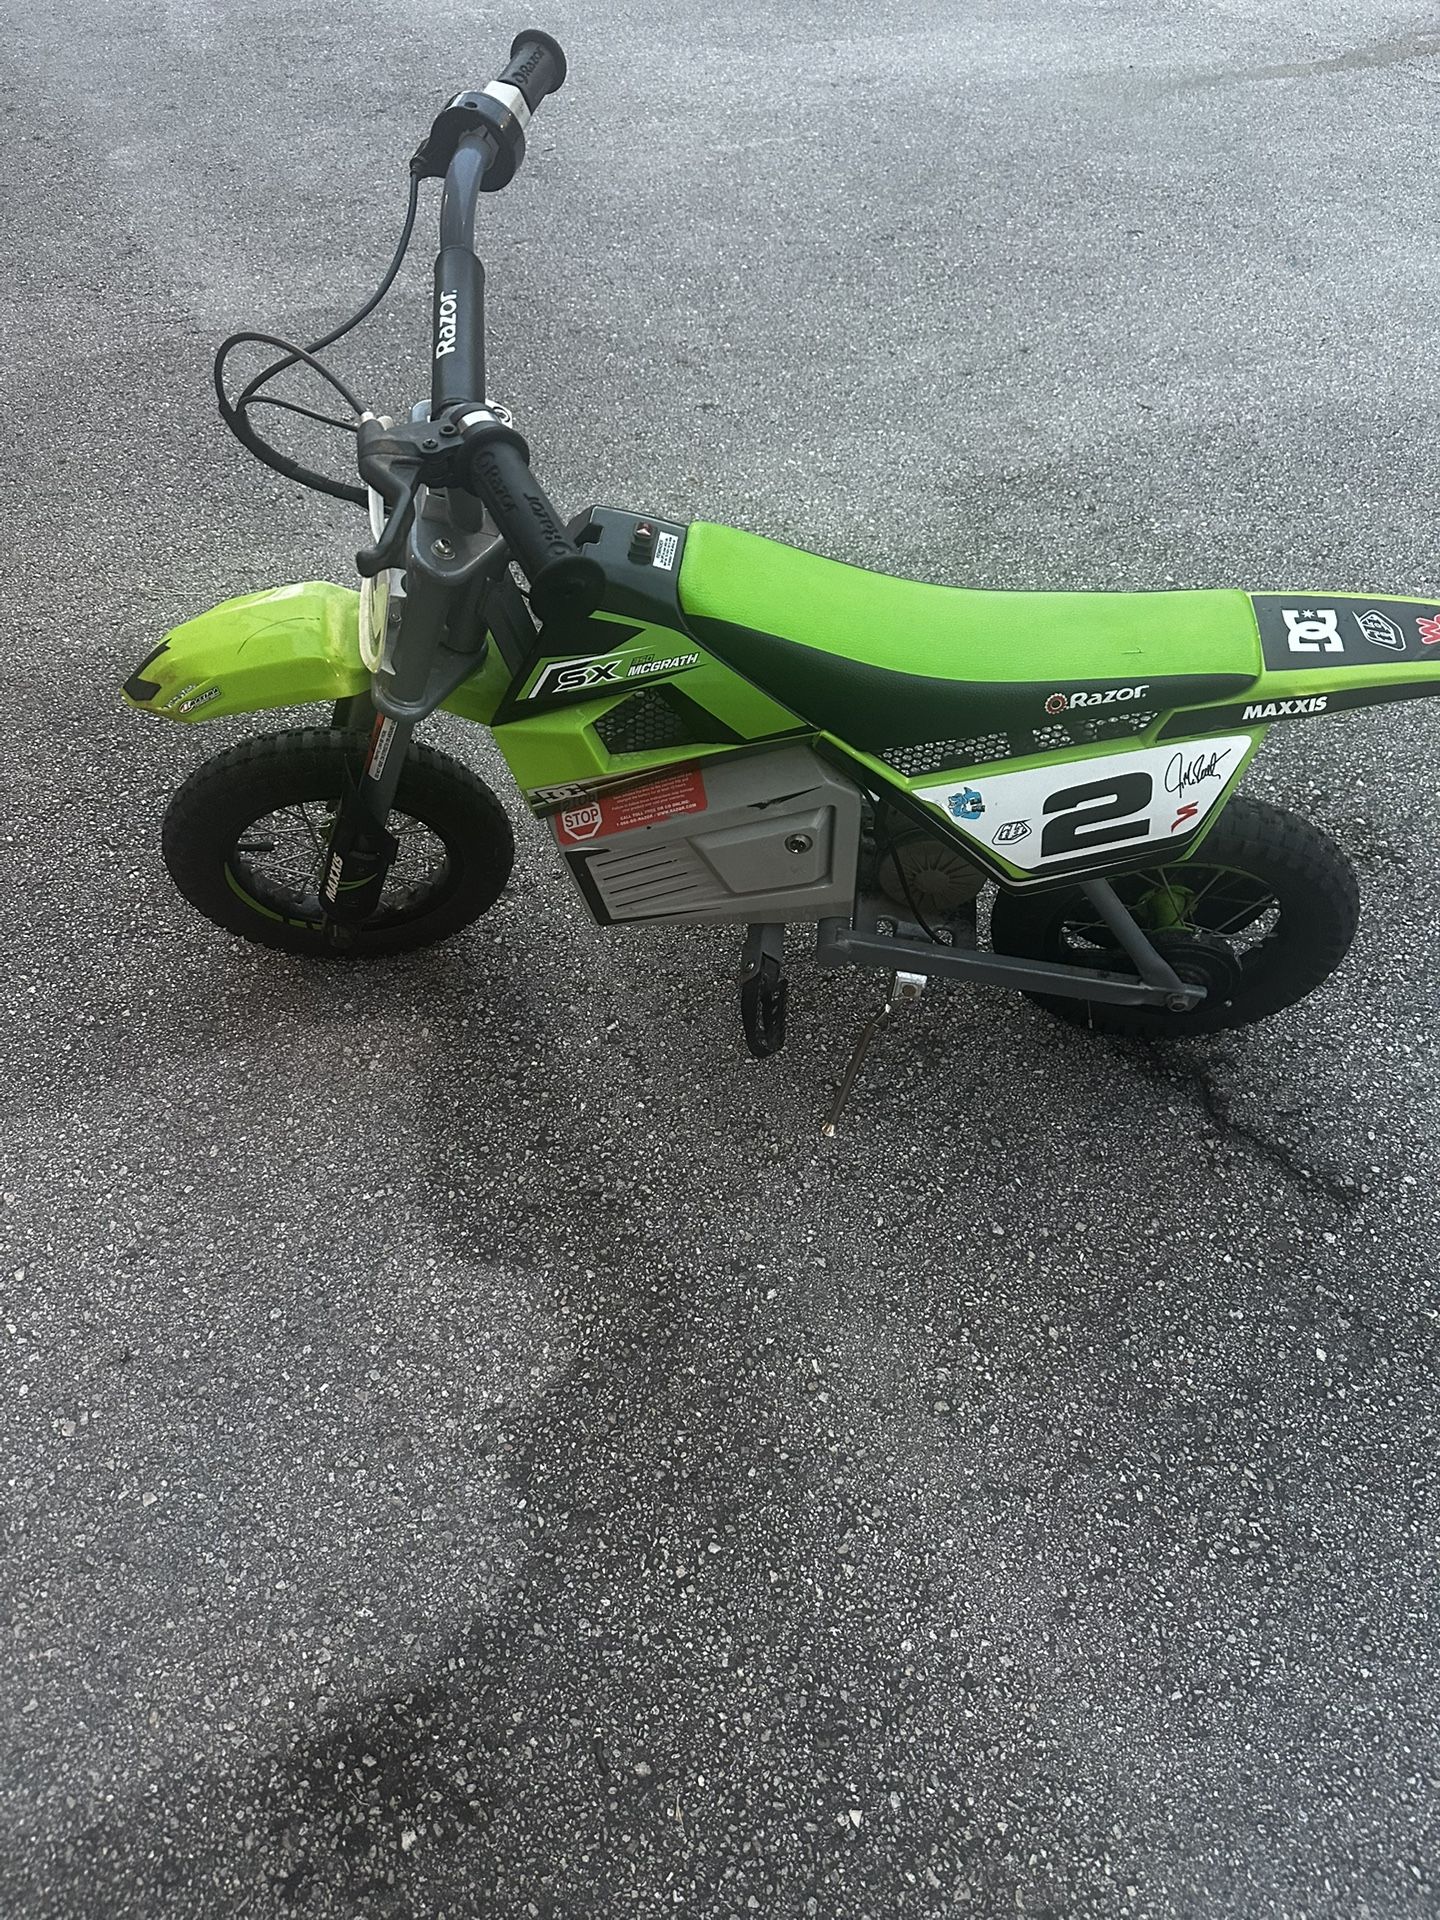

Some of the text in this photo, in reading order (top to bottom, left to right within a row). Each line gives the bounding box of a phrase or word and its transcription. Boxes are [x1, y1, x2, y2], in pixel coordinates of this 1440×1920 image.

[552, 652, 699, 693] SX MCGRATH
[1242, 696, 1328, 720] MAXXIS
[564, 809, 599, 828] STOP
[1041, 772, 1153, 857] 2
[325, 851, 344, 903] MAXXIS
